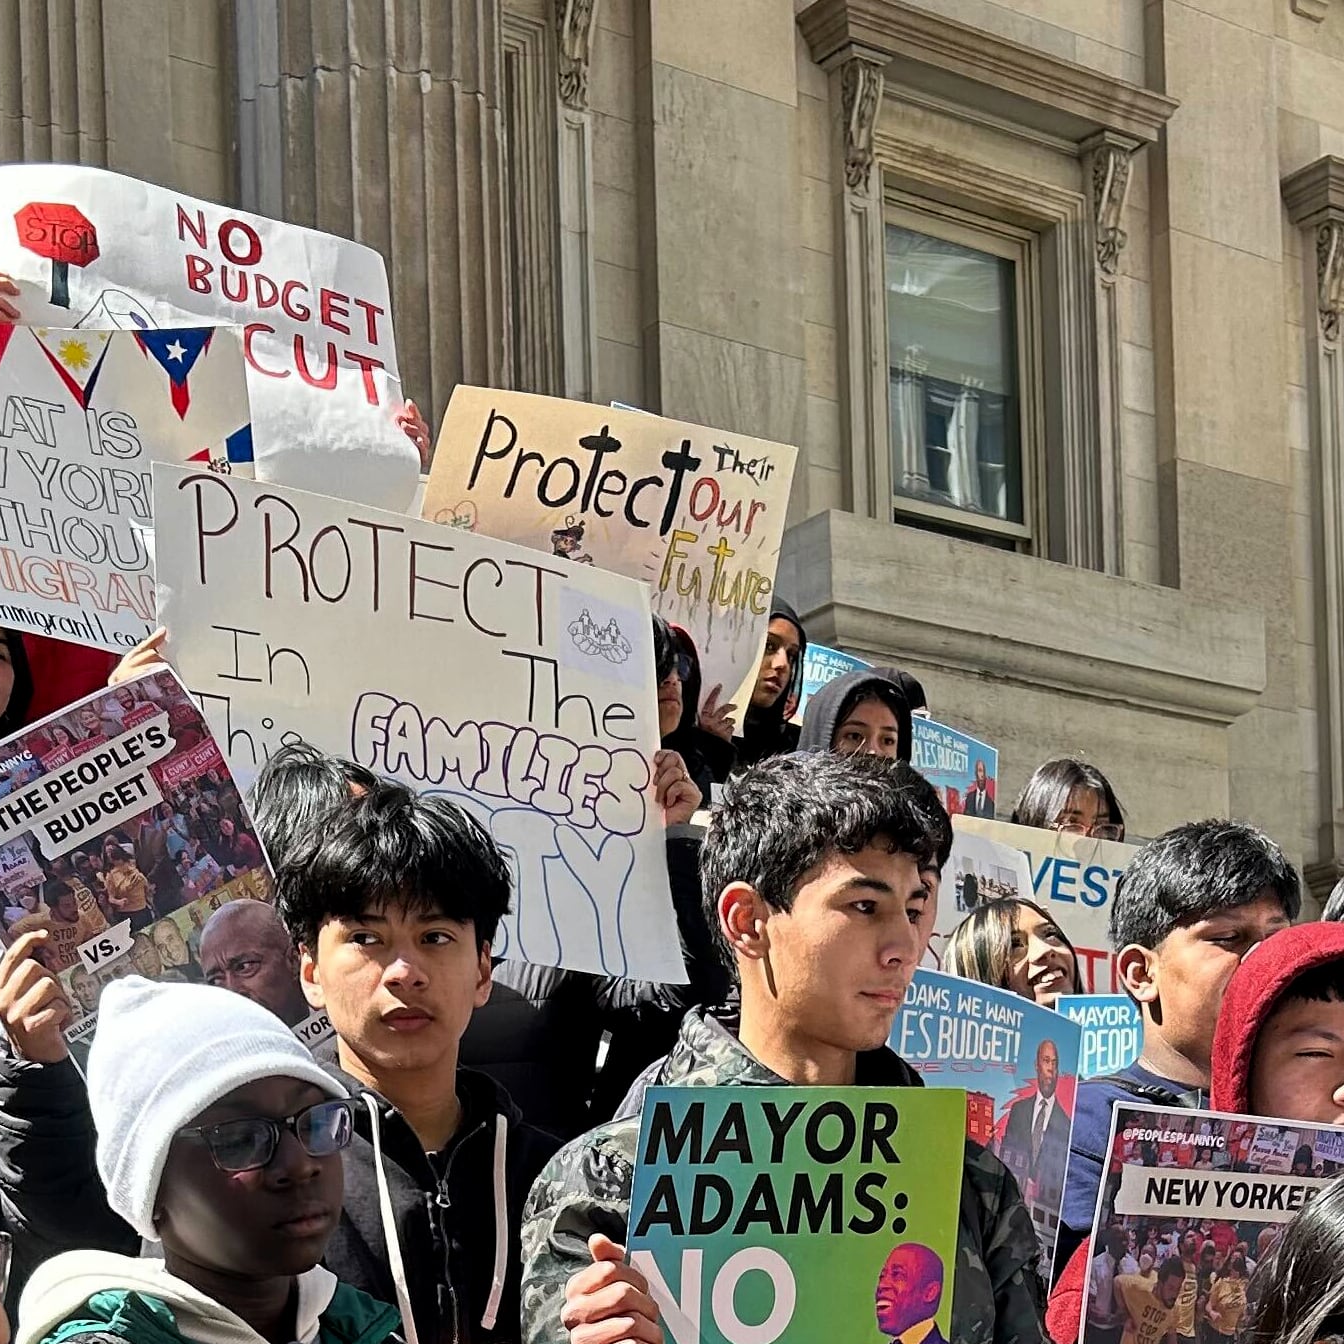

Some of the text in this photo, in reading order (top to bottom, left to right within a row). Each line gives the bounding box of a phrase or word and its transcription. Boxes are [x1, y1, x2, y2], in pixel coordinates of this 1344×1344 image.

[26, 217, 99, 255] STOP
[176, 202, 262, 266] NO
[186, 254, 385, 346] BUDGET
[243, 322, 385, 407] CUT
[85, 407, 143, 460] IS
[689, 476, 767, 536] Our
[177, 472, 568, 647] PROTECT
[659, 528, 773, 616] Future
[211, 624, 637, 742] In The
[43, 725, 167, 812] PEOPLE'S
[351, 691, 650, 837] FAMILIES
[43, 772, 149, 845] BUDGET
[1018, 850, 1124, 908] VES
[52, 926, 78, 942] STOP
[84, 937, 122, 965] VS.
[937, 1016, 1022, 1063] BUDGET!
[957, 993, 983, 1017] WE
[984, 1001, 1025, 1028] WANT
[1069, 1006, 1130, 1027] MAYOR
[642, 1100, 902, 1166] MAYOR
[1122, 1127, 1226, 1149] @PEOPLESPLANNYC
[632, 1172, 909, 1238] ADAMS:
[1144, 1177, 1209, 1208] NEW
[1141, 1304, 1167, 1324] STOP
